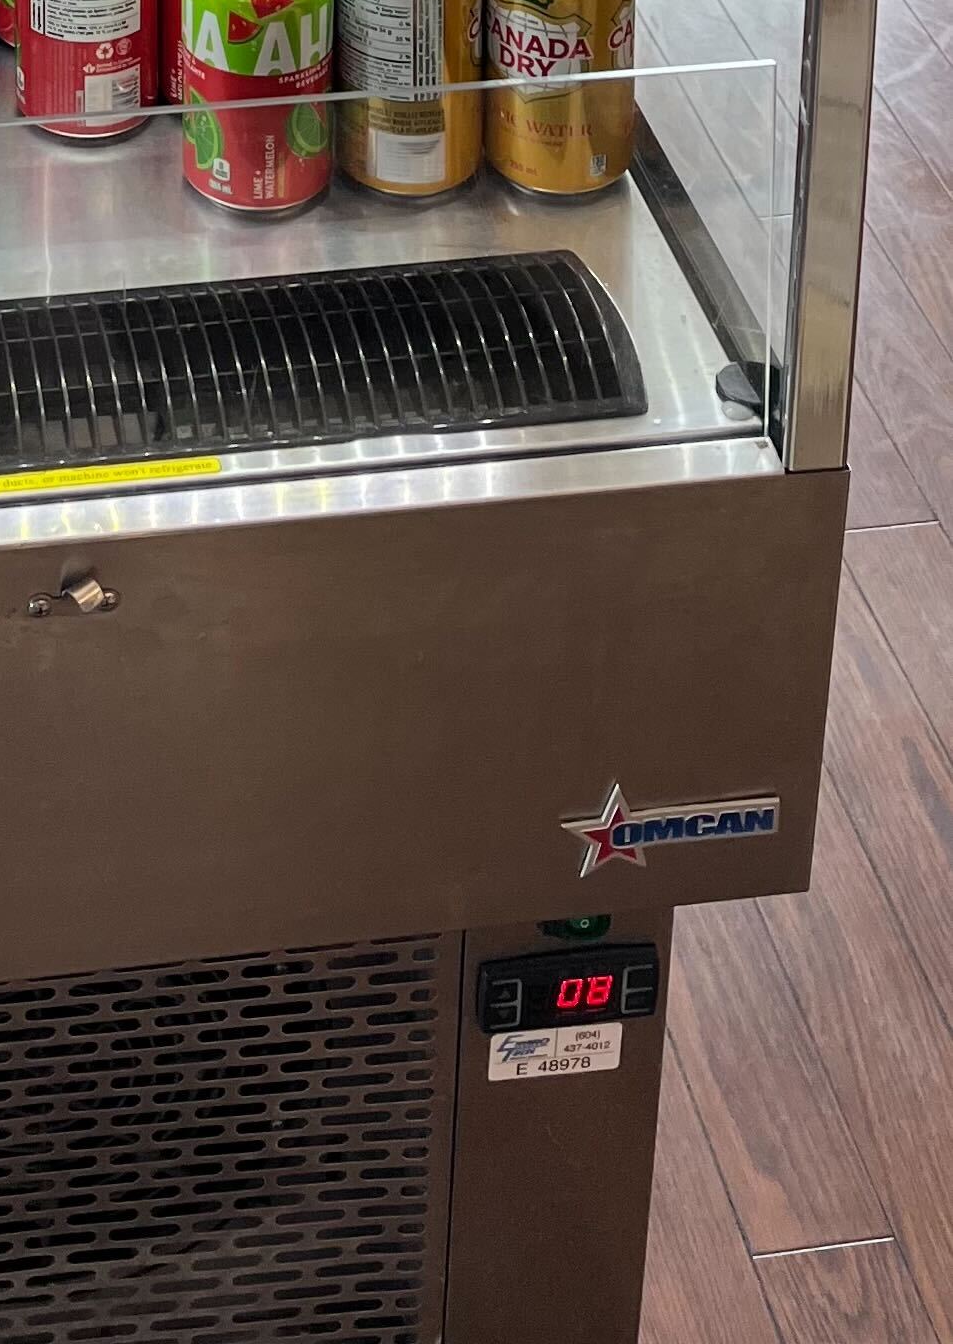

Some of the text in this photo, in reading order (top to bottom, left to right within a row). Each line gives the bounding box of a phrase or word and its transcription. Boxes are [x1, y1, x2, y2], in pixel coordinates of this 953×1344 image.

[499, 43, 557, 78] DRY
[264, 133, 276, 200] WATERMELON
[252, 176, 264, 200] LIME
[58, 470, 110, 484] machine
[112, 466, 147, 479] won't
[149, 460, 213, 476] refrigerate
[612, 808, 775, 846] OMCAN
[564, 1040, 611, 1053] 437-4012
[575, 1030, 601, 1042] (604)
[516, 1056, 591, 1076] E 48978
